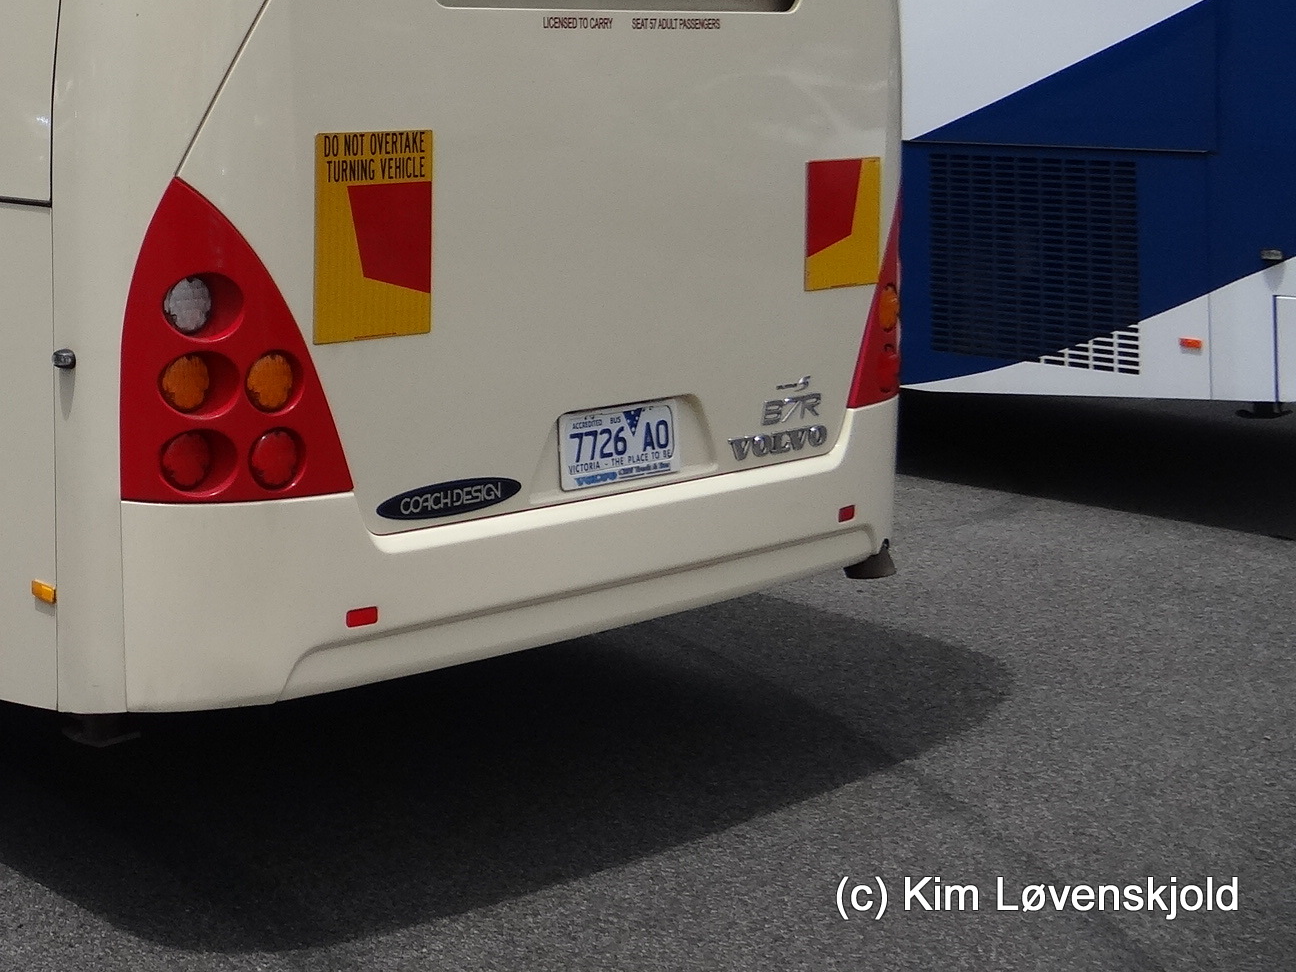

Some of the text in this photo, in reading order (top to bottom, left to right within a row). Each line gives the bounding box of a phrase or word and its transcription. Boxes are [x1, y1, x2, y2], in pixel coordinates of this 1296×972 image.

[543, 17, 614, 30] LICENSED TO CARRY
[632, 18, 649, 30] SEAT
[658, 18, 679, 30] ADULT
[679, 18, 721, 30] PASSENGERS
[324, 131, 426, 157] DO NOT OVERTAKE
[326, 156, 426, 183] TURNING VEHICLE
[609, 416, 622, 425] BUS
[569, 426, 628, 463] 7726
[727, 425, 828, 462] VOLVO
[568, 461, 601, 475] VICTORIA
[611, 456, 624, 466] THE
[627, 453, 649, 464] PLACE
[651, 451, 660, 460] TO
[400, 481, 502, 515] COACH DESIGN
